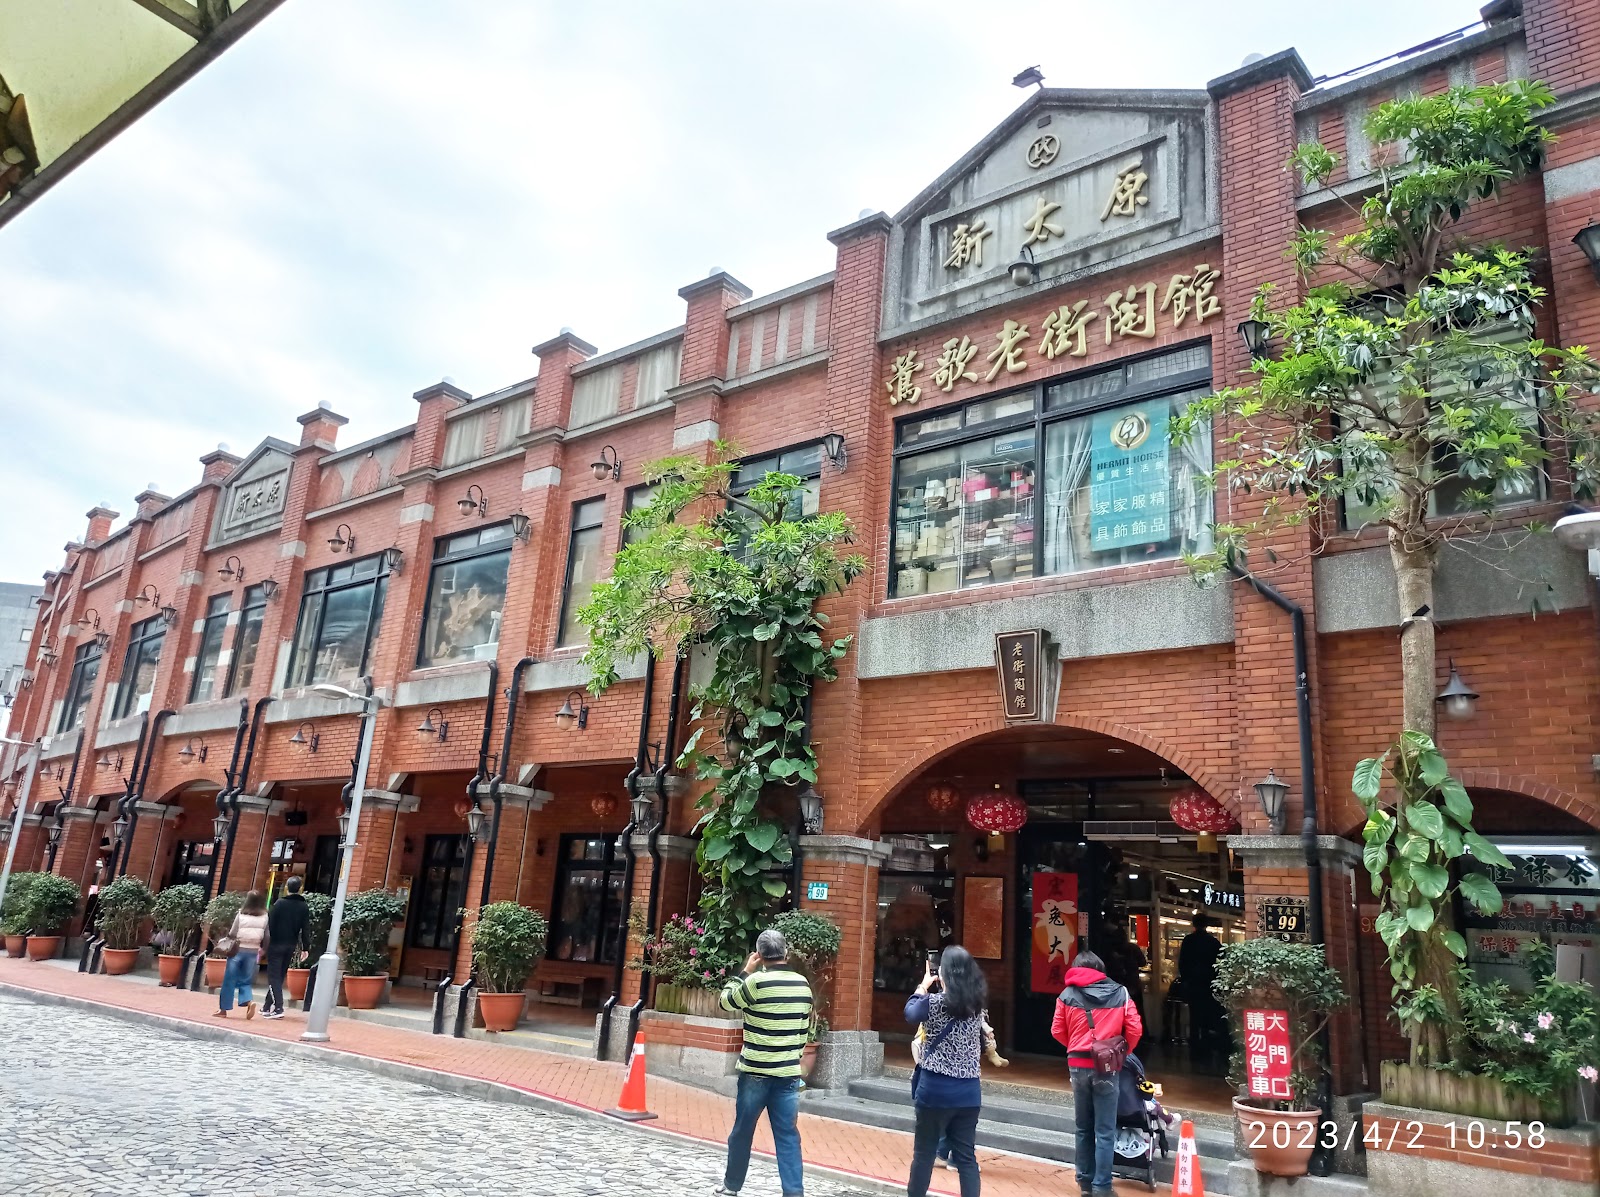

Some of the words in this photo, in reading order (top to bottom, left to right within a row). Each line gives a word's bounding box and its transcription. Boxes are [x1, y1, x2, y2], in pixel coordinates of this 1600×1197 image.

[944, 161, 1149, 270] 新太原
[886, 264, 1222, 406] 鶯歌老街陶館
[1097, 457, 1130, 470] HERMIT
[1133, 450, 1164, 464] HORSE
[1012, 642, 1027, 709] 老街陶館
[815, 888, 825, 898] 99
[1278, 915, 1297, 931] 99
[1479, 936, 1520, 953] 保證
[1246, 1012, 1271, 1096] 請勿停車
[1266, 1013, 1291, 1097] 大門口
[1180, 1142, 1189, 1188] 請勿停車
